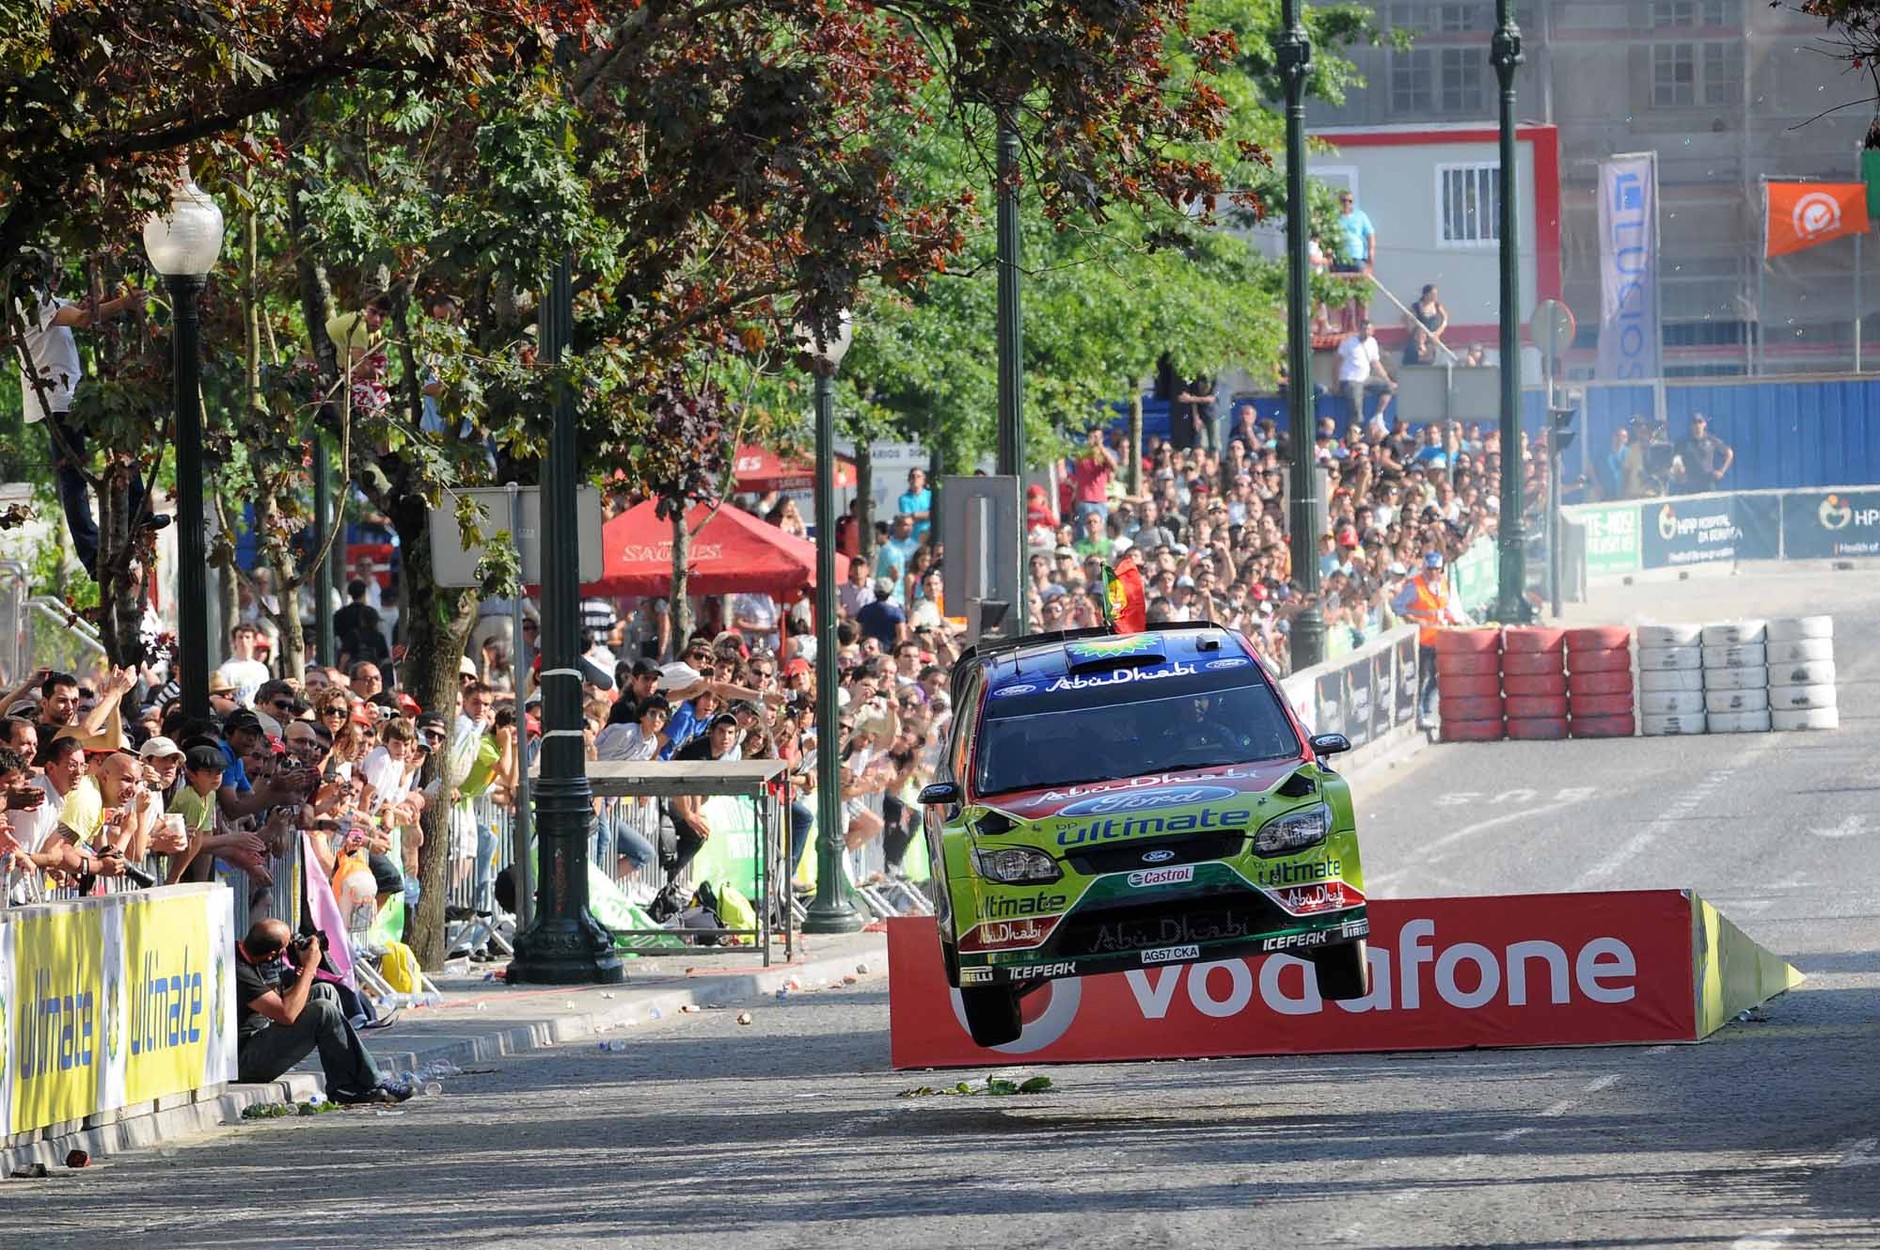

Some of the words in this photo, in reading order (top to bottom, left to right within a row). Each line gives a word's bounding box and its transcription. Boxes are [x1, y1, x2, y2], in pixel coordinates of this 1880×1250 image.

[622, 543, 723, 562] SAGES
[1090, 788, 1210, 814] Ford
[1056, 808, 1251, 846] ultimate
[1143, 868, 1190, 884] Castrol
[1258, 855, 1341, 885] ultimate
[1340, 918, 1370, 938] PIRE
[1262, 930, 1328, 952] ICEPEAK
[1143, 950, 1172, 962] AG57
[1173, 947, 1198, 959] CKA
[1008, 961, 1077, 981] ICEPEAK
[129, 944, 204, 1057] ultimate
[20, 962, 95, 1082] ultimate
